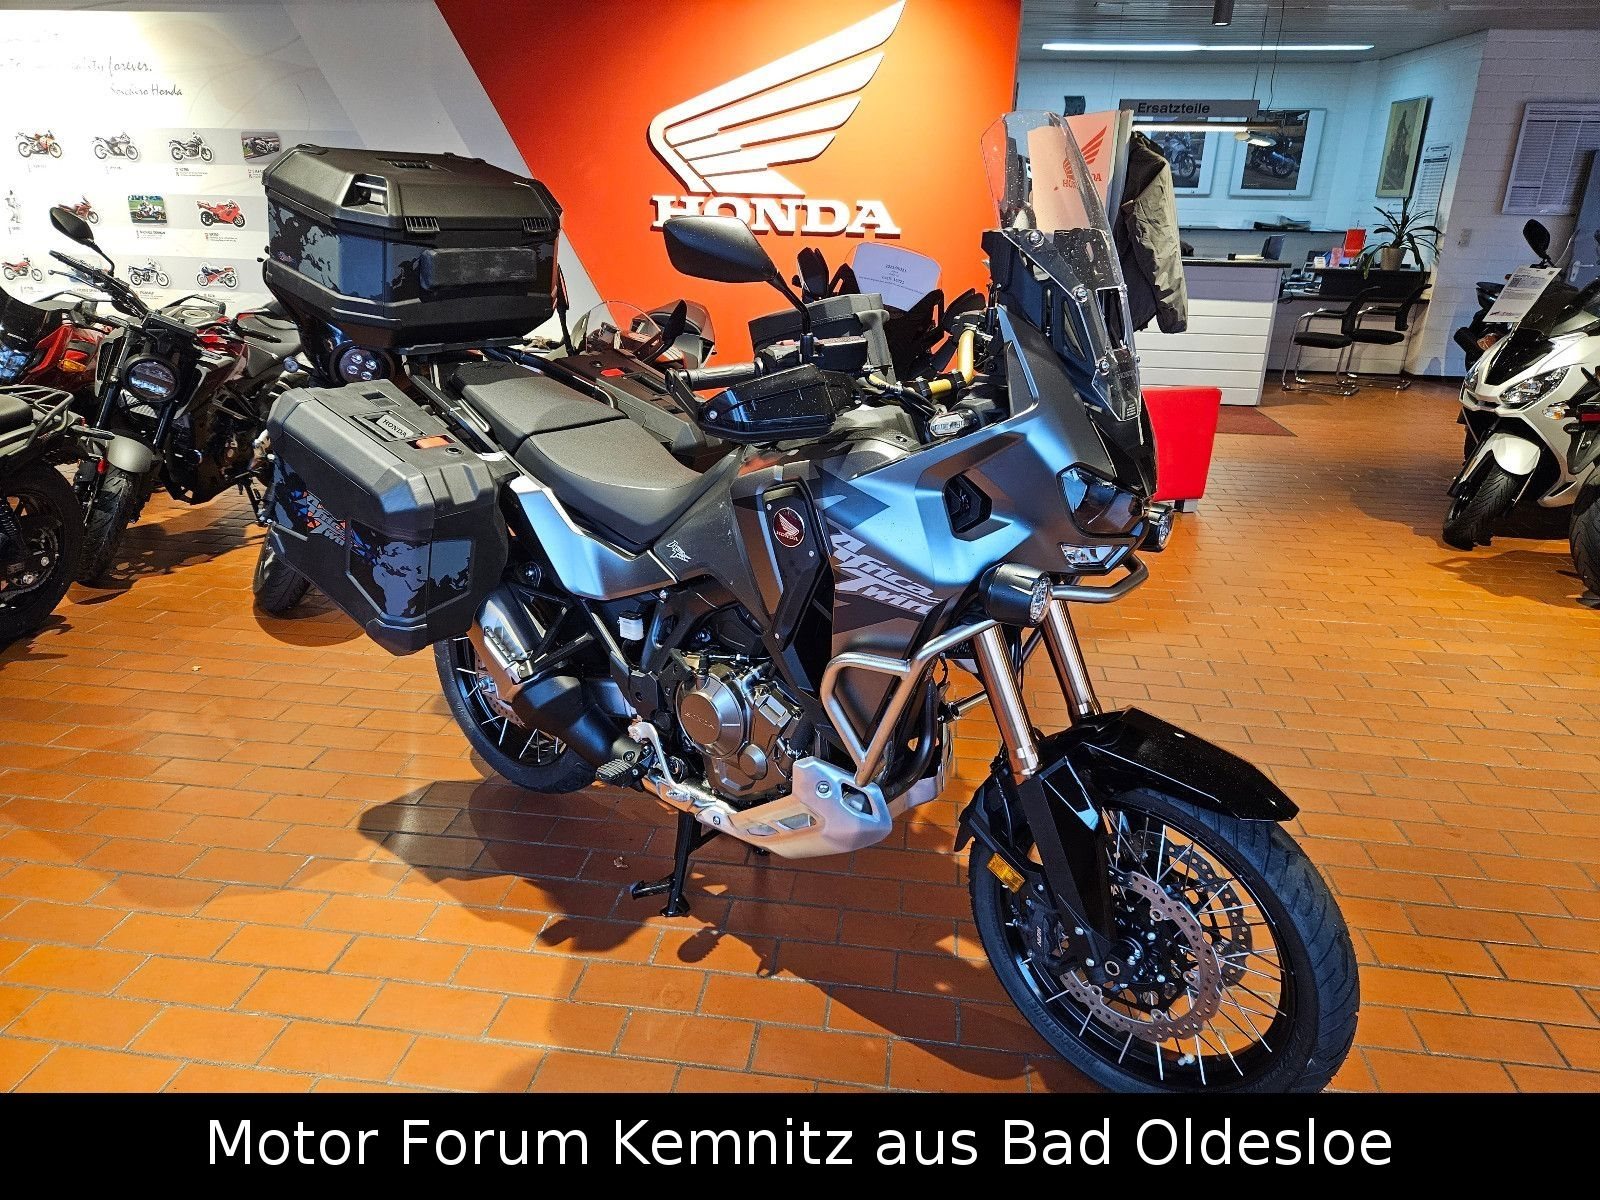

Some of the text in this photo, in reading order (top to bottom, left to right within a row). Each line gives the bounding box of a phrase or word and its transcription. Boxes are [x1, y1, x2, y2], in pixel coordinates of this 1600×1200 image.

[151, 83, 183, 96] Honda
[1137, 102, 1210, 114] Ersatzteile
[650, 195, 901, 238] HONDA
[382, 419, 407, 438] HONDA
[776, 530, 799, 541] HONDA
[829, 530, 943, 601] Africa
[835, 567, 940, 615] Twin
